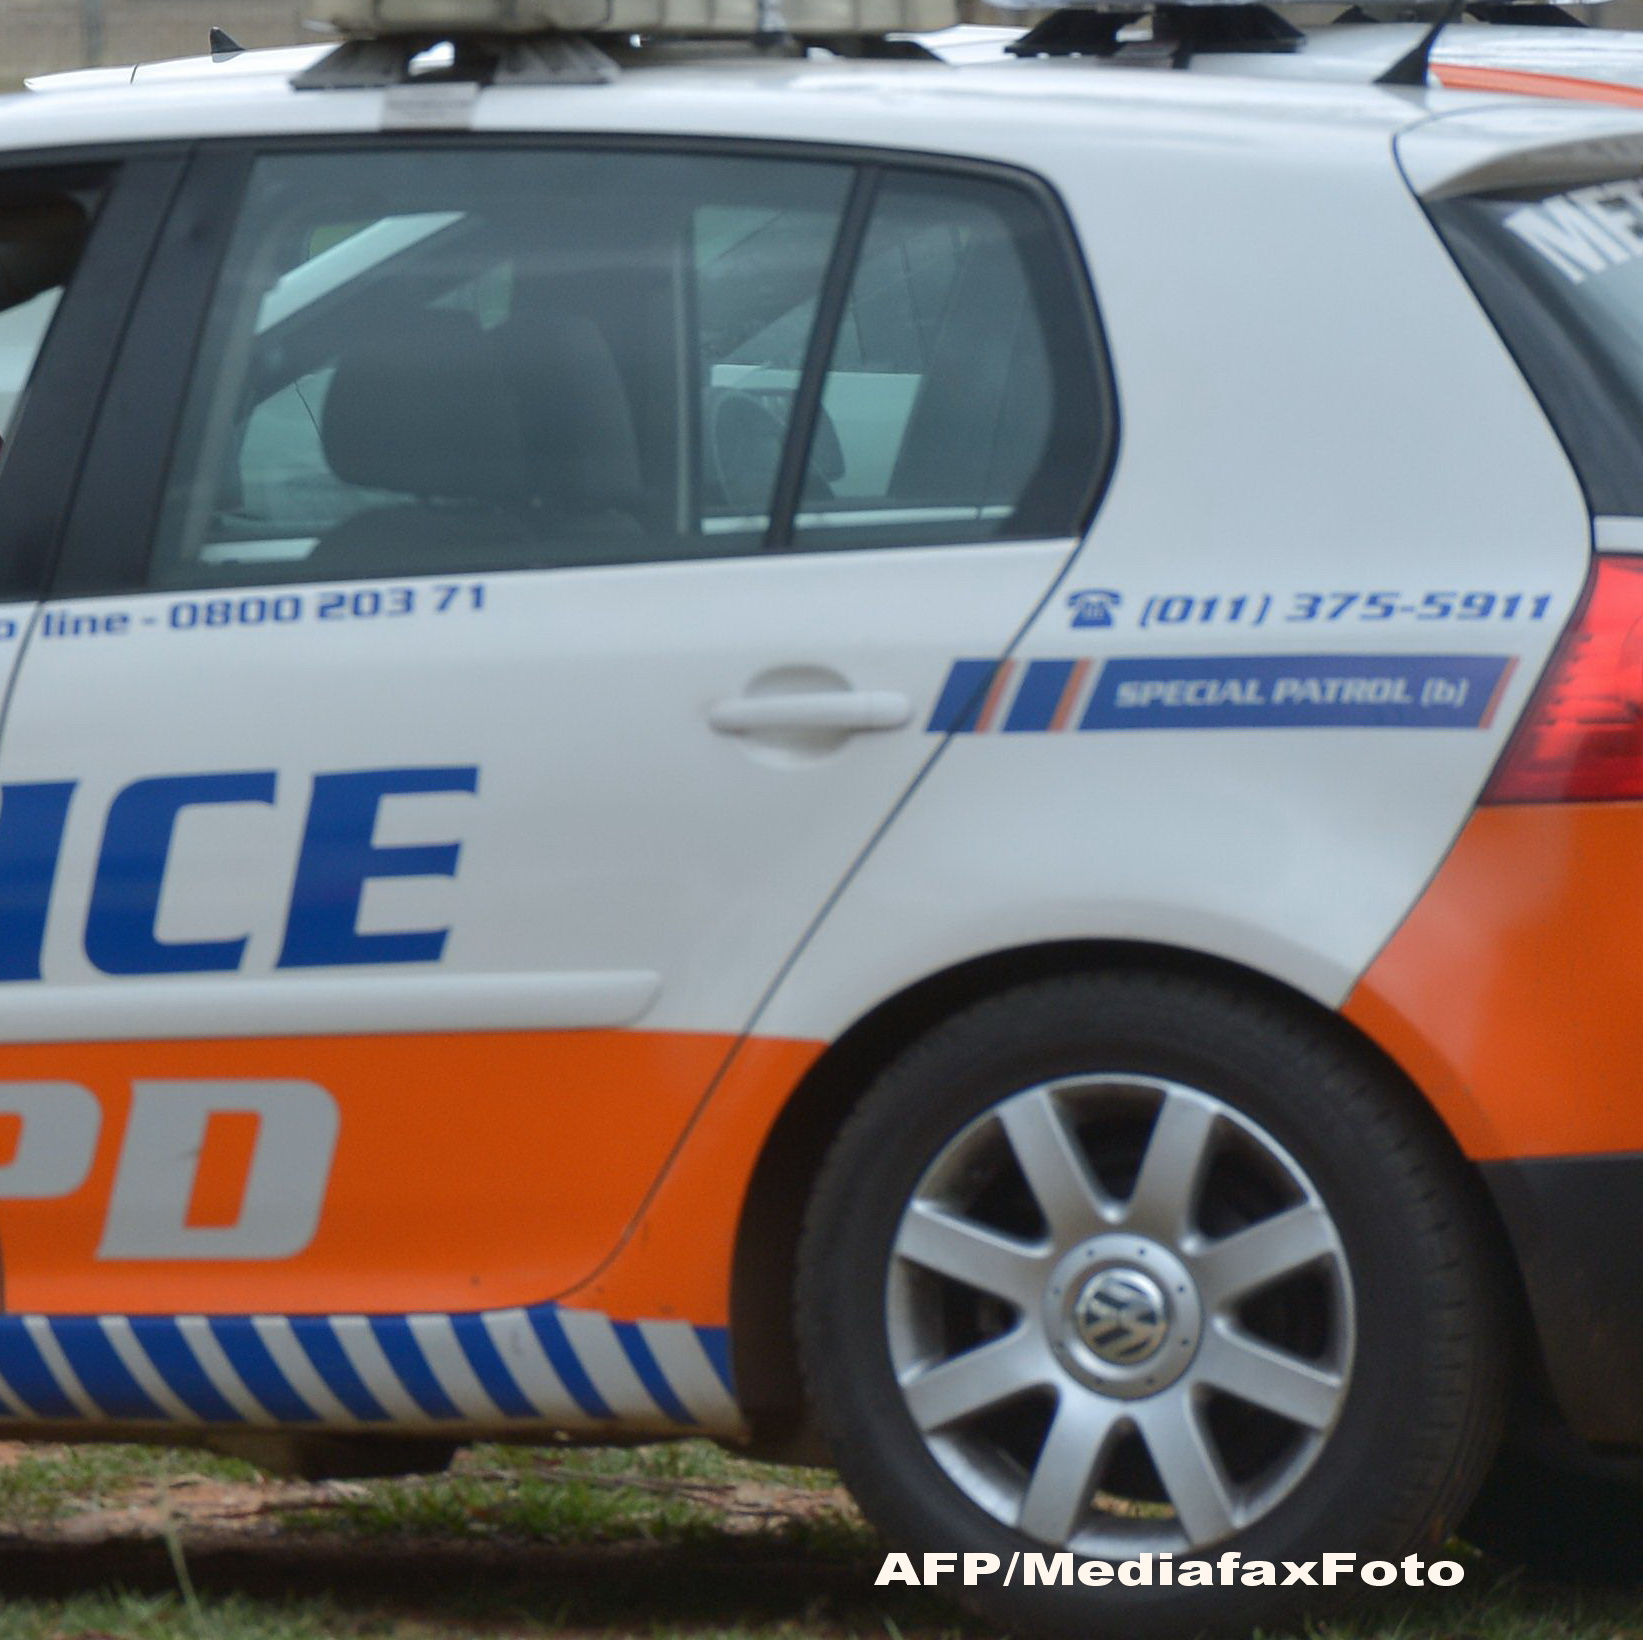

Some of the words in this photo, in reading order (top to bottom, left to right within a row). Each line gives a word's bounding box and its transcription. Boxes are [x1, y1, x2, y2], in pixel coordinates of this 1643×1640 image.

[168, 594, 302, 631] 0800
[316, 586, 414, 620] 203
[432, 583, 487, 613] 71
[1138, 594, 1273, 629] (011)
[1285, 591, 1553, 622] 375-5911
[1116, 678, 1265, 708] SPECIAL
[1272, 676, 1413, 706] PATROL
